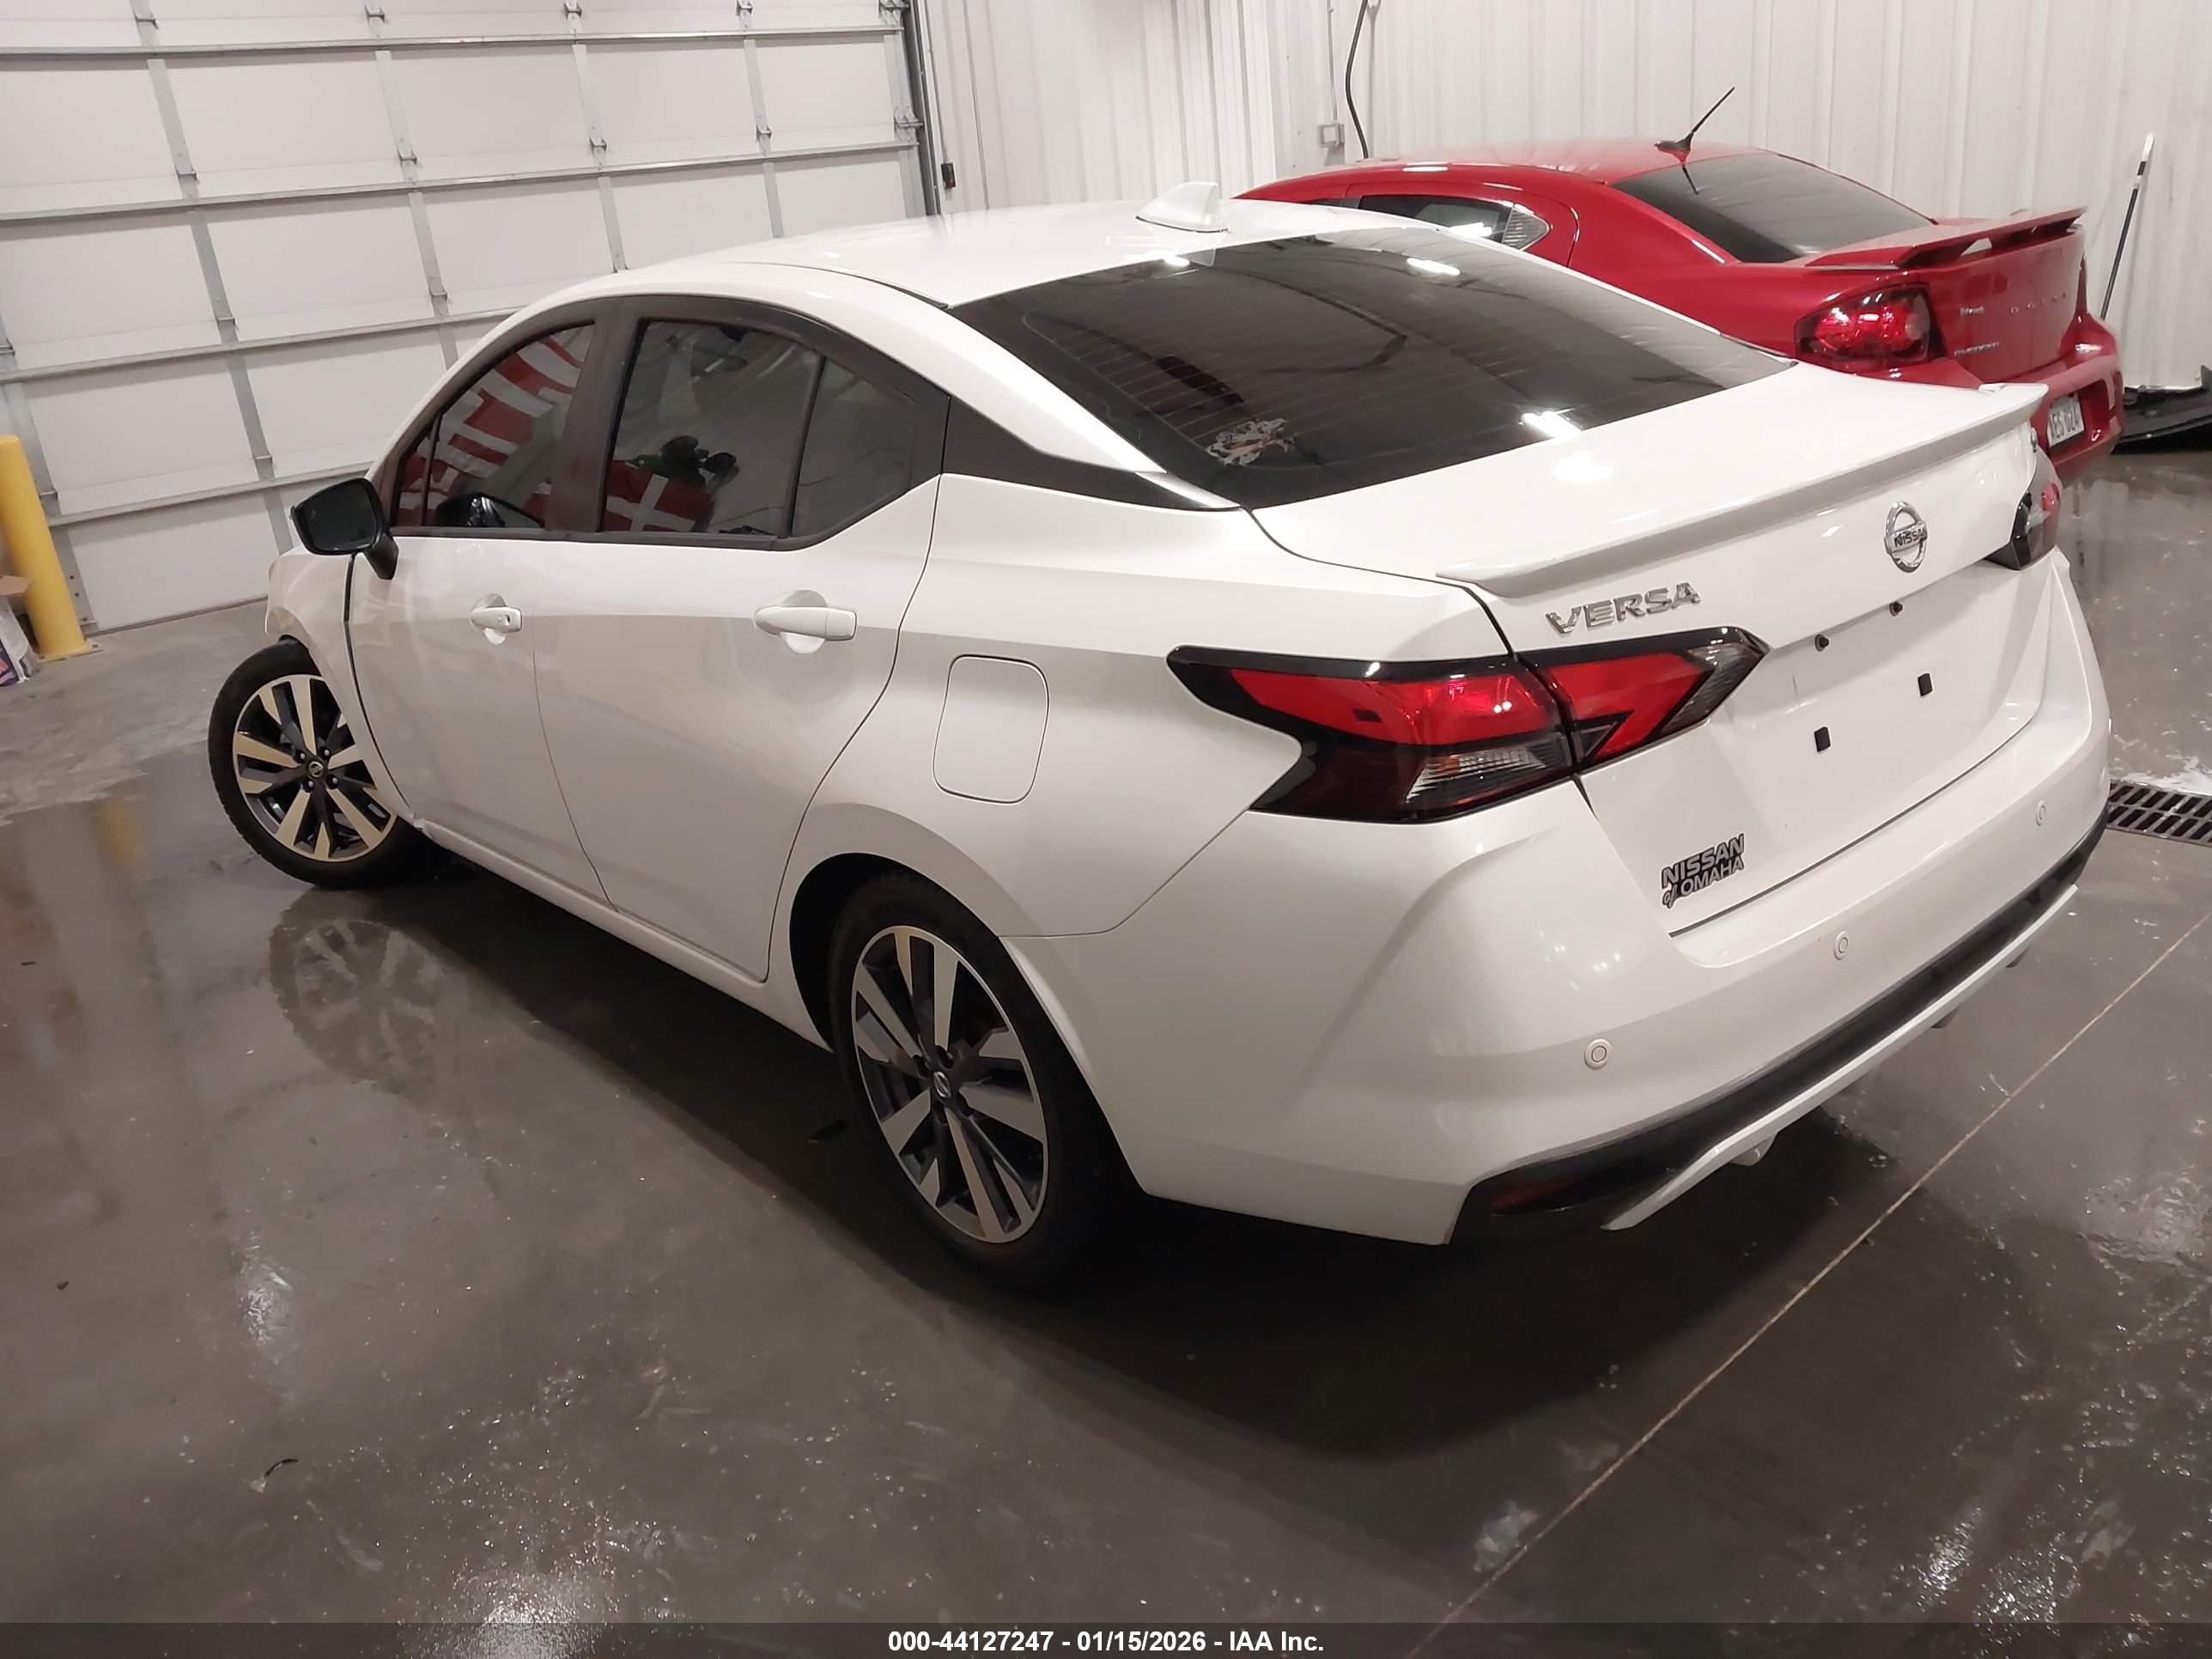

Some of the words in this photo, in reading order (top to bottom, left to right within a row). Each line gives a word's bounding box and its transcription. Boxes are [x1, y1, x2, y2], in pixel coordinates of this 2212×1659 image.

[1546, 581, 1702, 634] VERSA
[1662, 833, 1744, 888] NISSAN
[1662, 884, 1677, 908] of
[1680, 856, 1744, 896] OMAHA
